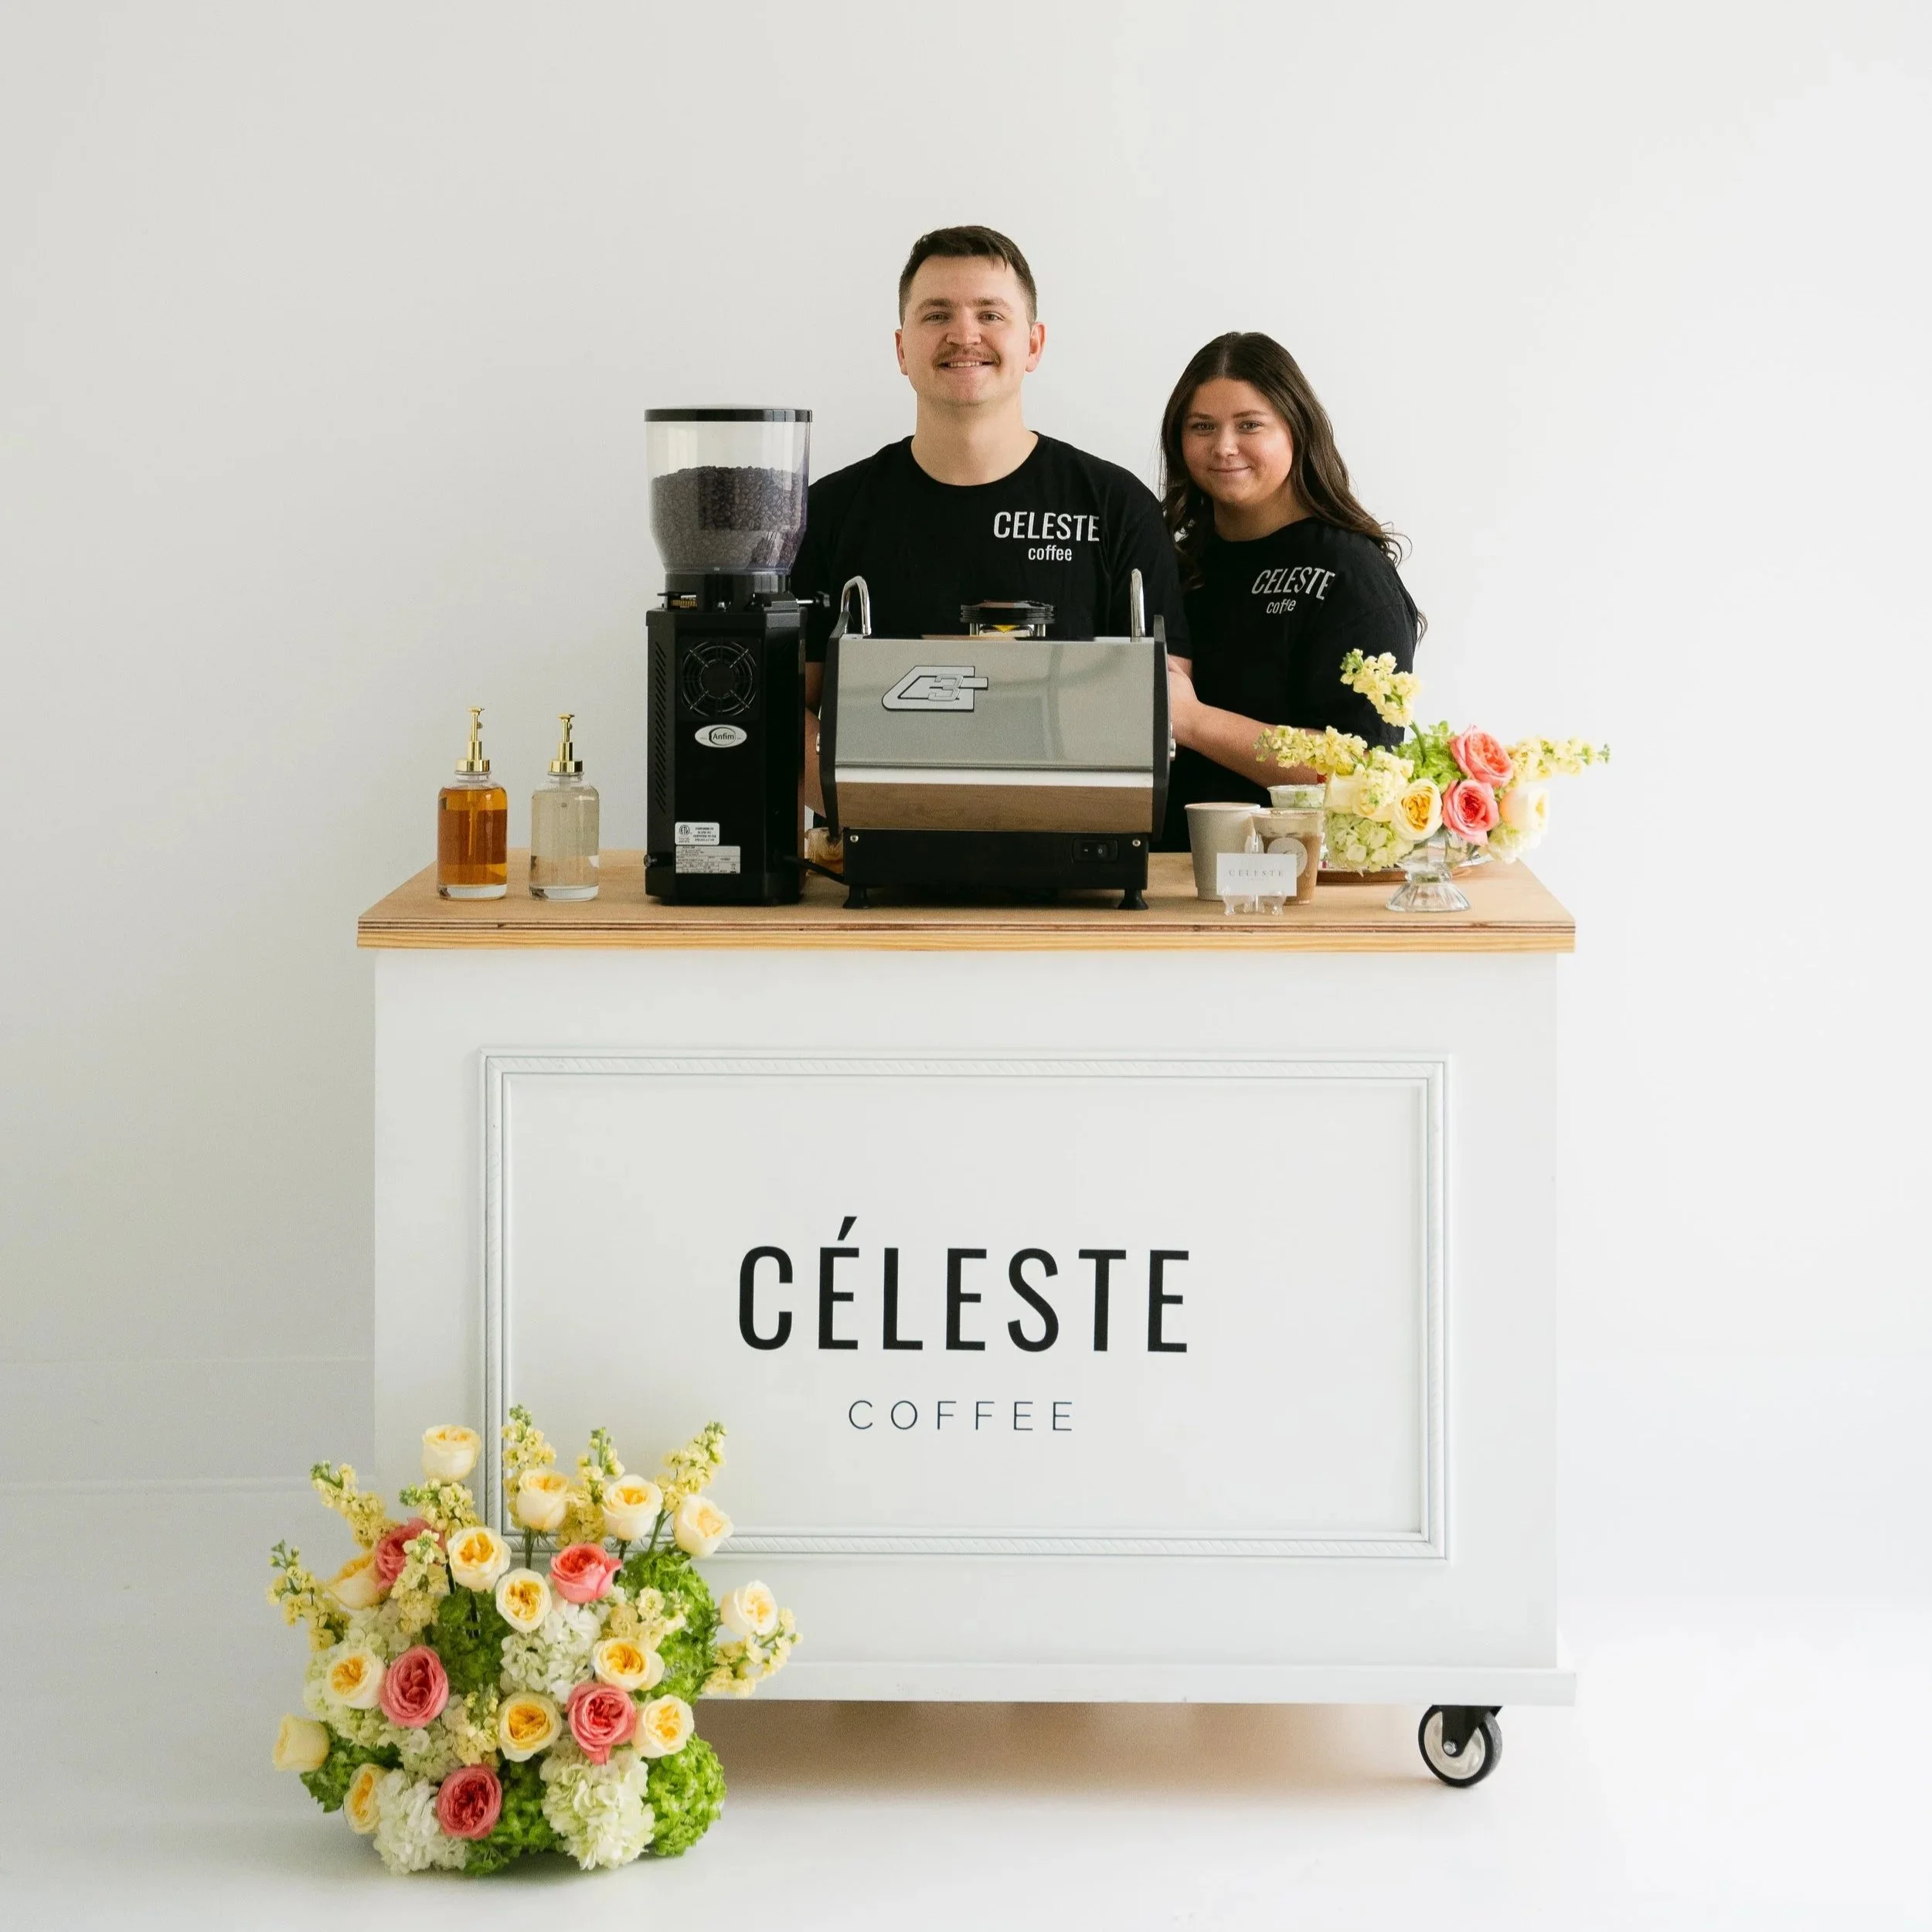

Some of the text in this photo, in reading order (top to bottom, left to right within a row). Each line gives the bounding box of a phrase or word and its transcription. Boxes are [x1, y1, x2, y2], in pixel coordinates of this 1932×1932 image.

[994, 512, 1099, 541] CELESTE
[1029, 545, 1072, 561] coffee
[1252, 566, 1335, 600] CELESTE
[740, 1216, 1189, 1352] CÉLESTE
[849, 1400, 1072, 1430] COFFEE
